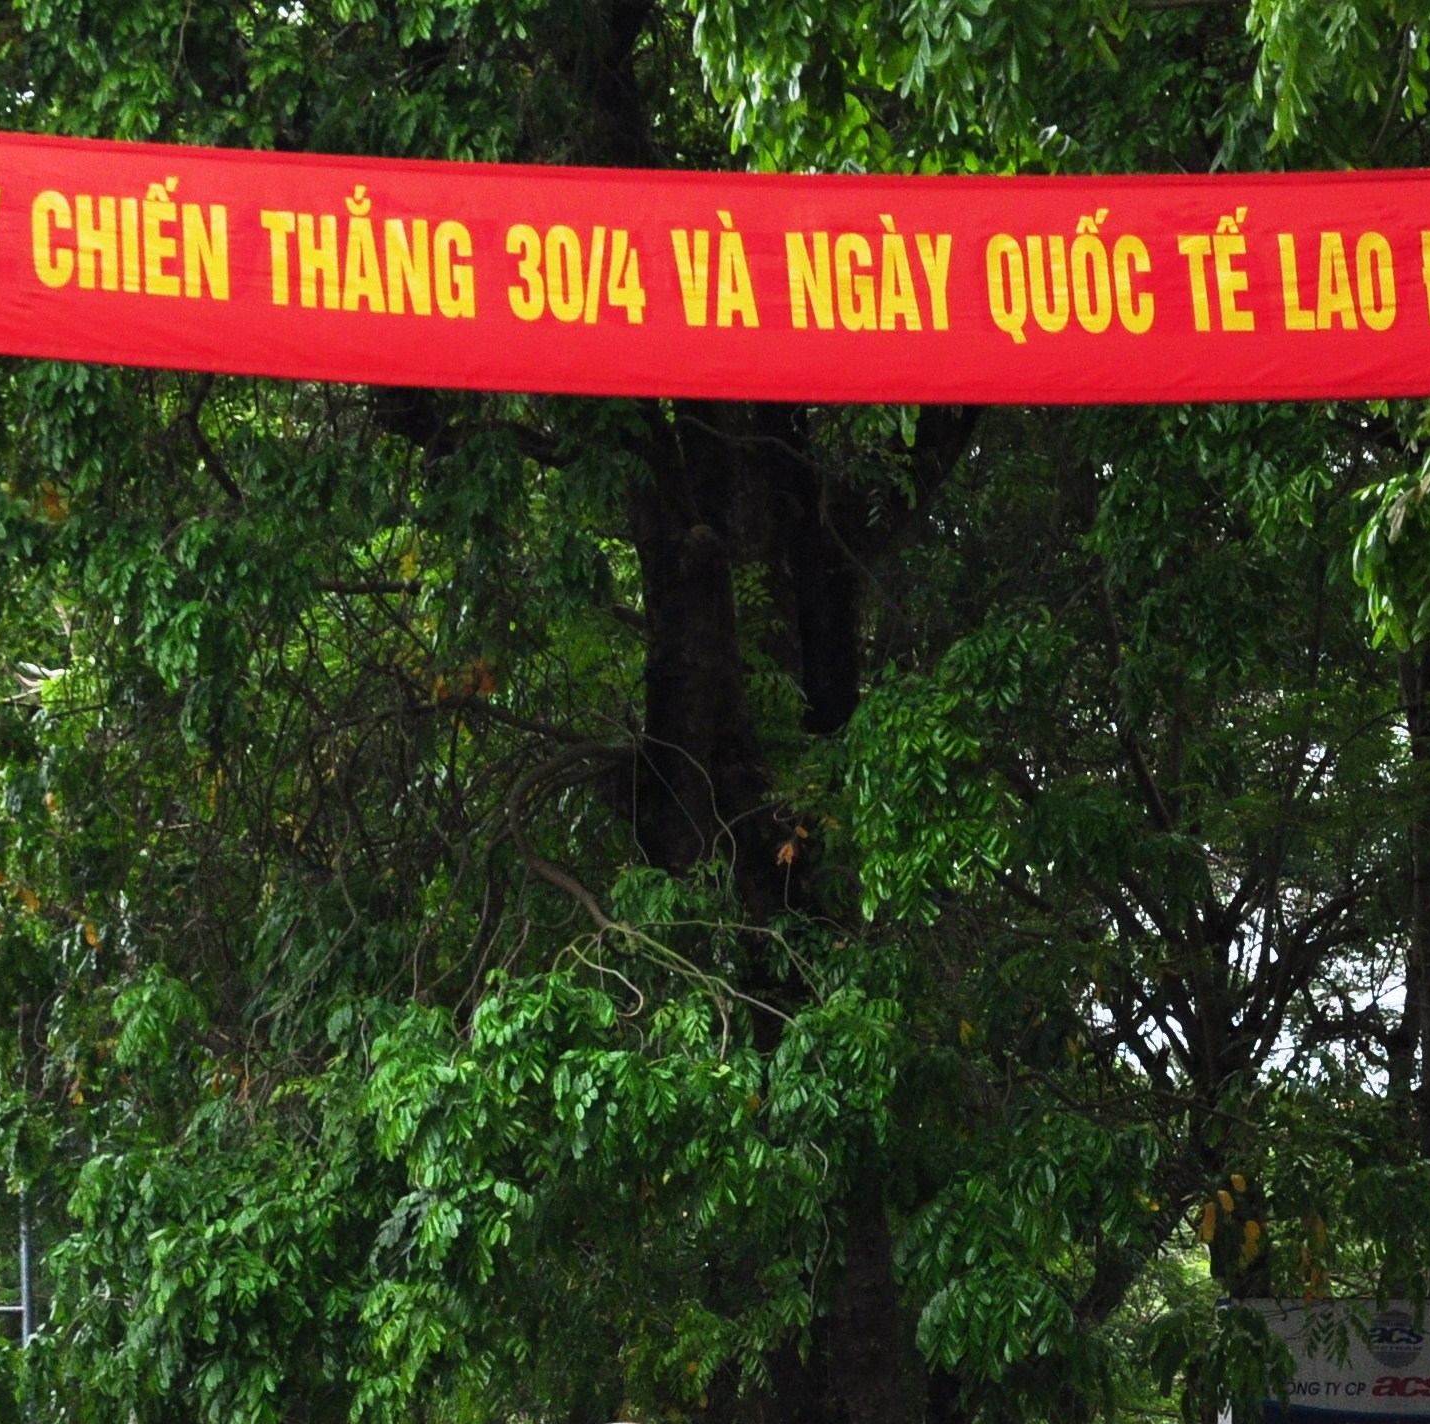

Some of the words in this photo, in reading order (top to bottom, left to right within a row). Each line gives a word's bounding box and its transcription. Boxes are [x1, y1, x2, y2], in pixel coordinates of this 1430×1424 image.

[30, 175, 229, 300] CHIẾN
[259, 184, 475, 319] THẮNG
[505, 223, 646, 324] 30/4
[670, 209, 759, 328] VÀ
[784, 213, 952, 331] NGÀY
[985, 207, 1154, 344] QUỐC
[1177, 206, 1254, 332] TẾ
[1277, 231, 1396, 332] LAO
[1325, 1381, 1341, 1395] TY
[1345, 1381, 1367, 1396] CP
